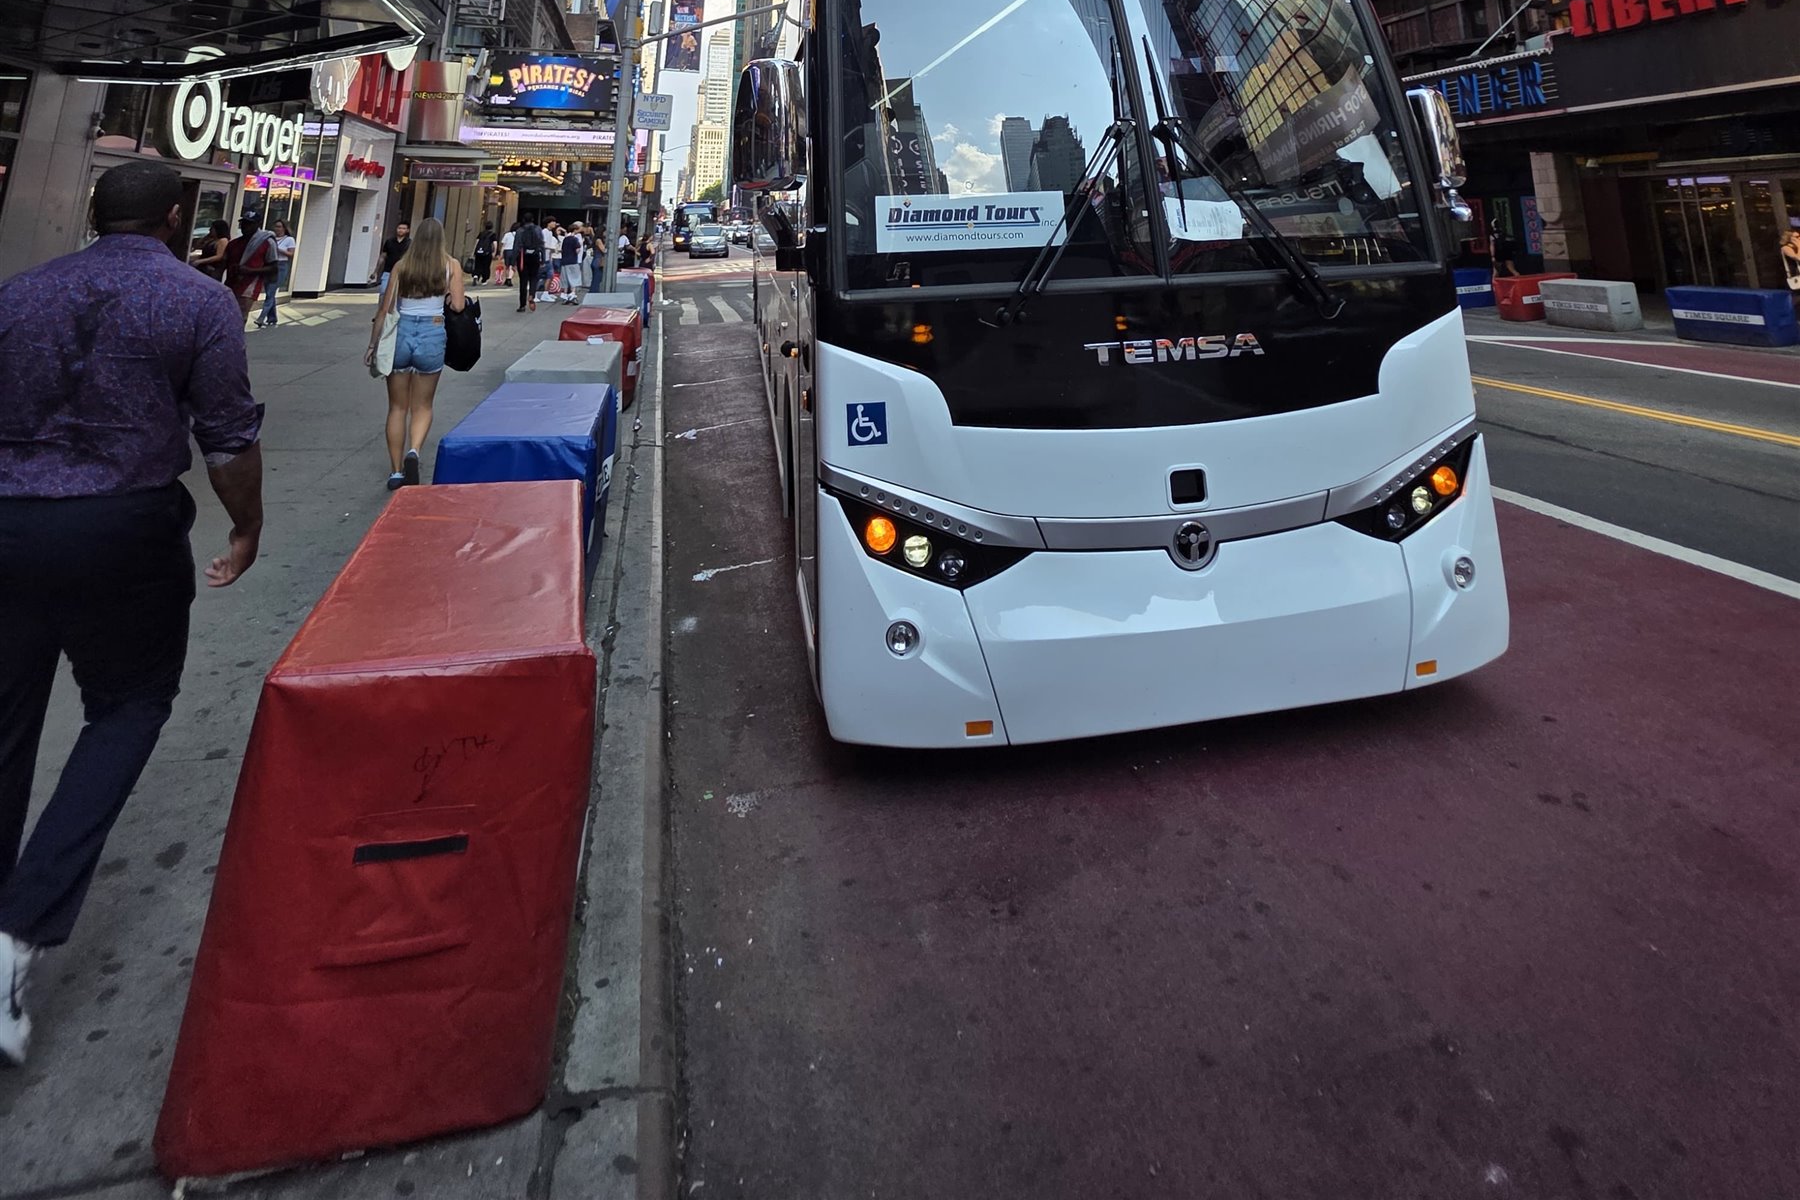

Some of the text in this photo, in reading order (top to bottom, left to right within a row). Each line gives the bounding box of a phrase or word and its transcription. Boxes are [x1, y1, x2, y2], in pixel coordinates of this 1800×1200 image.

[508, 62, 597, 94] PIRATES!
[1407, 61, 1547, 116] INER
[642, 94, 667, 104] NYPD
[637, 109, 669, 119] SECURITY
[637, 116, 667, 126] CAMERA
[217, 101, 304, 174] target
[887, 200, 1041, 224] Diamond Tours
[1041, 218, 1058, 228] inc.
[905, 230, 1024, 243] www.diamondtours.com
[1683, 310, 1751, 323] TIMES SQUARE
[1083, 332, 1266, 367] TEMSA
